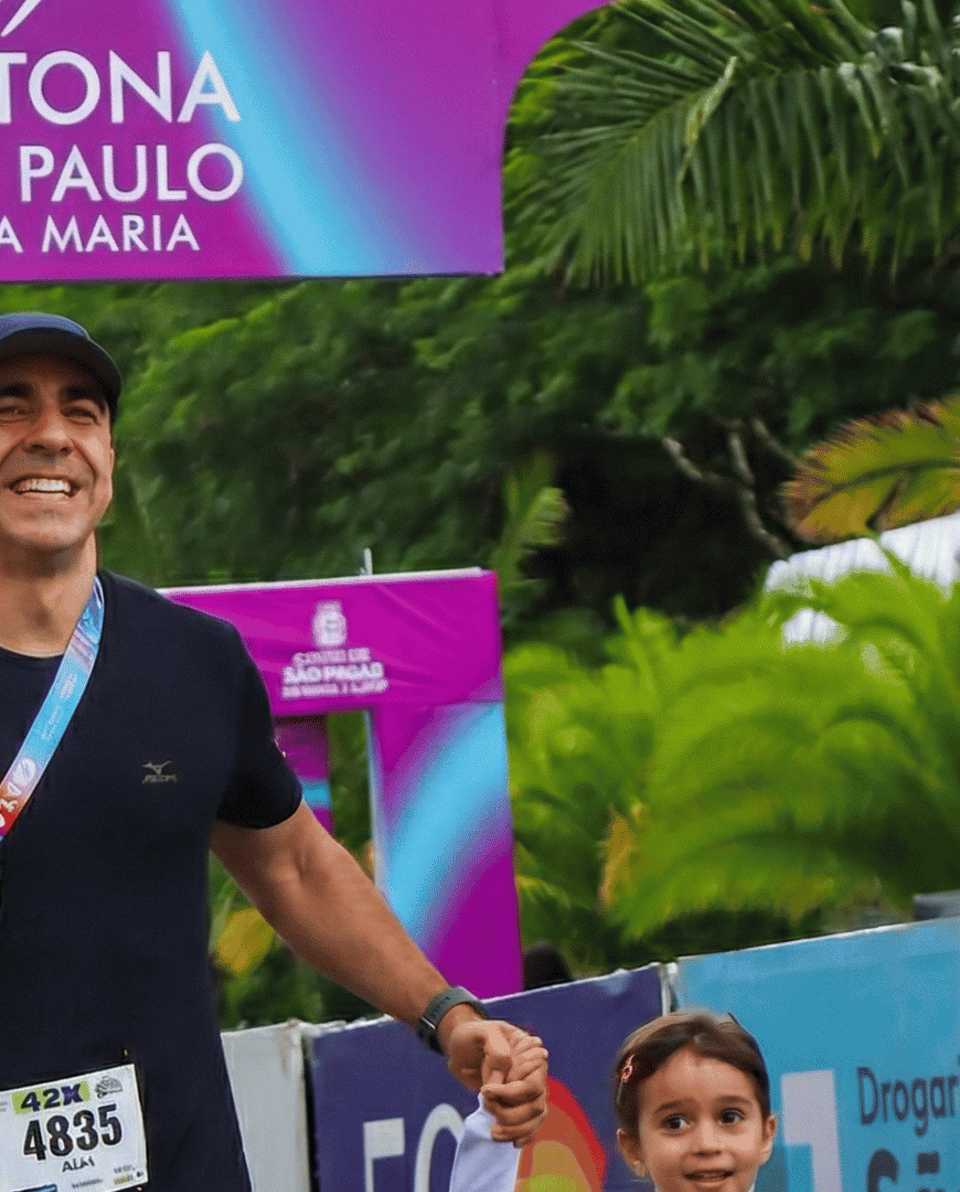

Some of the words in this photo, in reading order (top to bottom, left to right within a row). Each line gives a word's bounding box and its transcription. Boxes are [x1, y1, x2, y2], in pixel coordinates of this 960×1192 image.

[20, 143, 243, 202] PAULO
[42, 214, 200, 254] MARIA
[856, 1064, 960, 1137] Drogar
[23, 1103, 123, 1161] 4835
